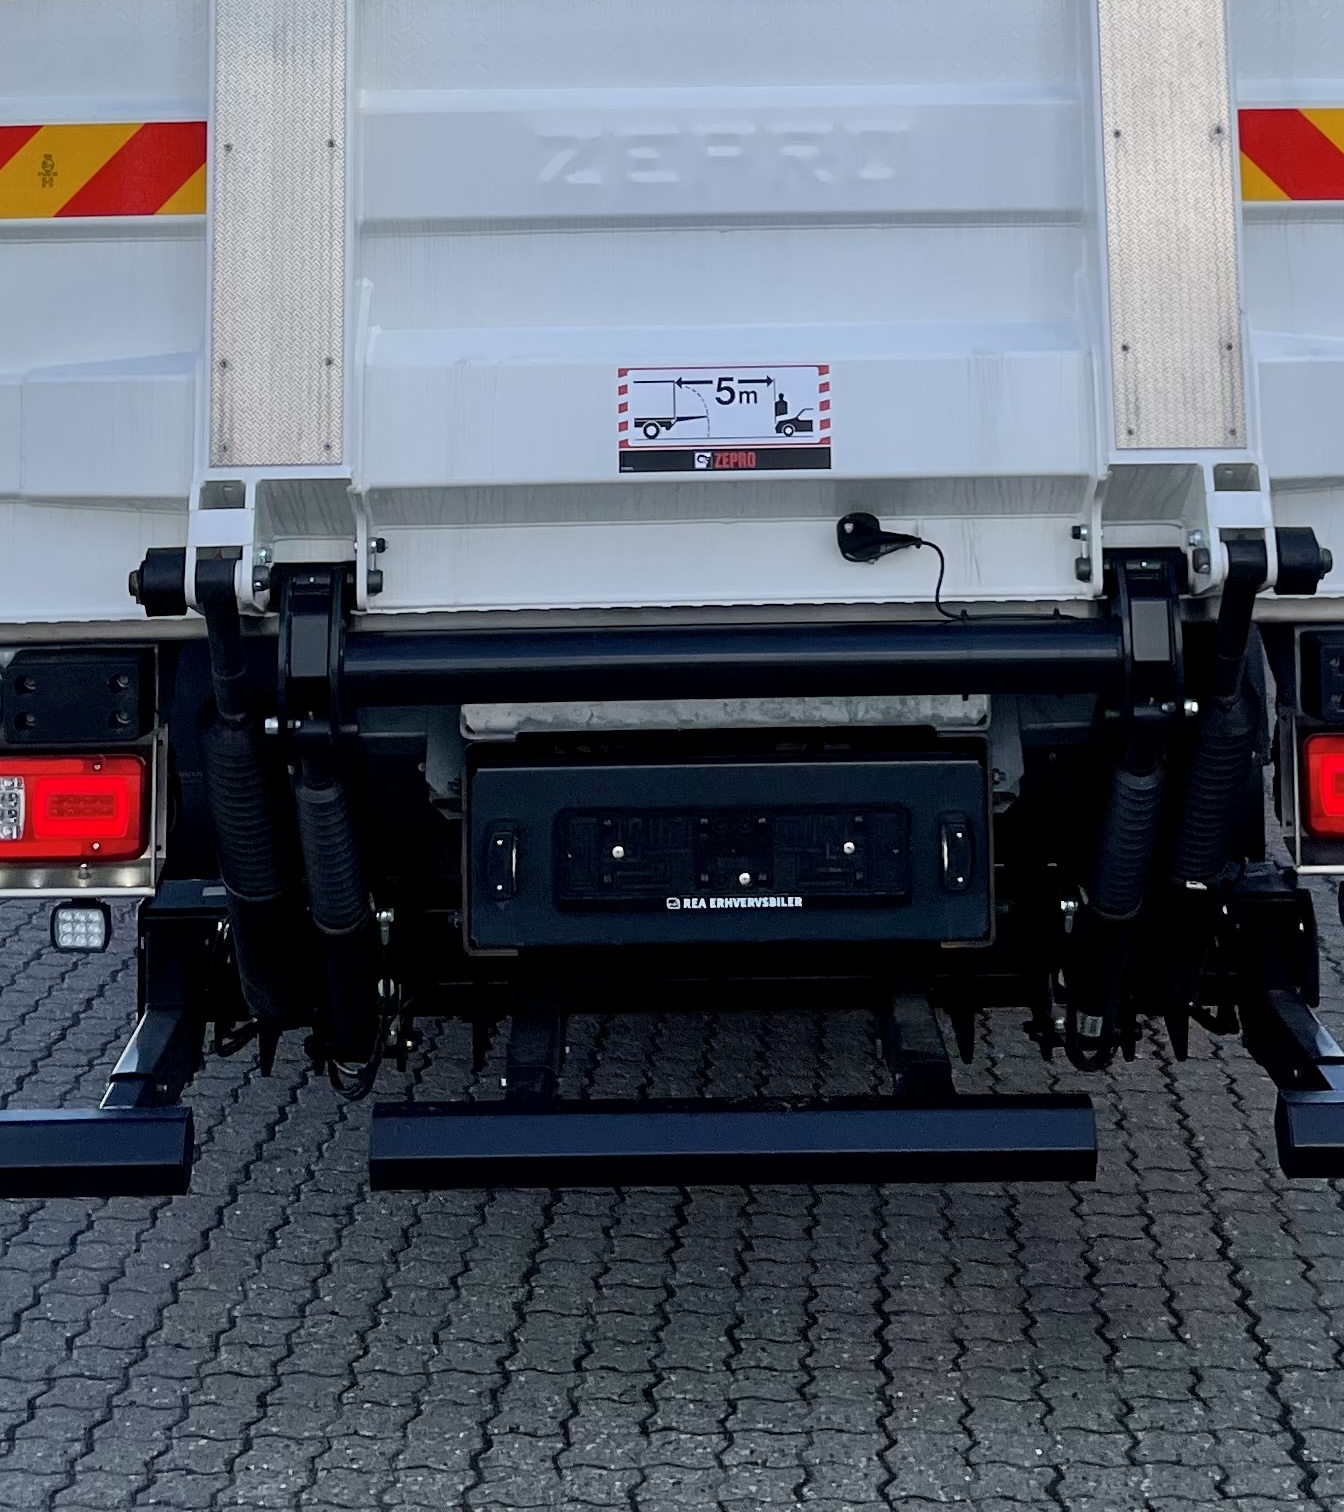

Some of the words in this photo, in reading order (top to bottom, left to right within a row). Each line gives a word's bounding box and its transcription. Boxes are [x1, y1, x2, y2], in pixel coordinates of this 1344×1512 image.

[714, 451, 756, 469] ZEPRO
[683, 898, 707, 909] REA
[709, 896, 803, 908] ERHVERVSBILER
